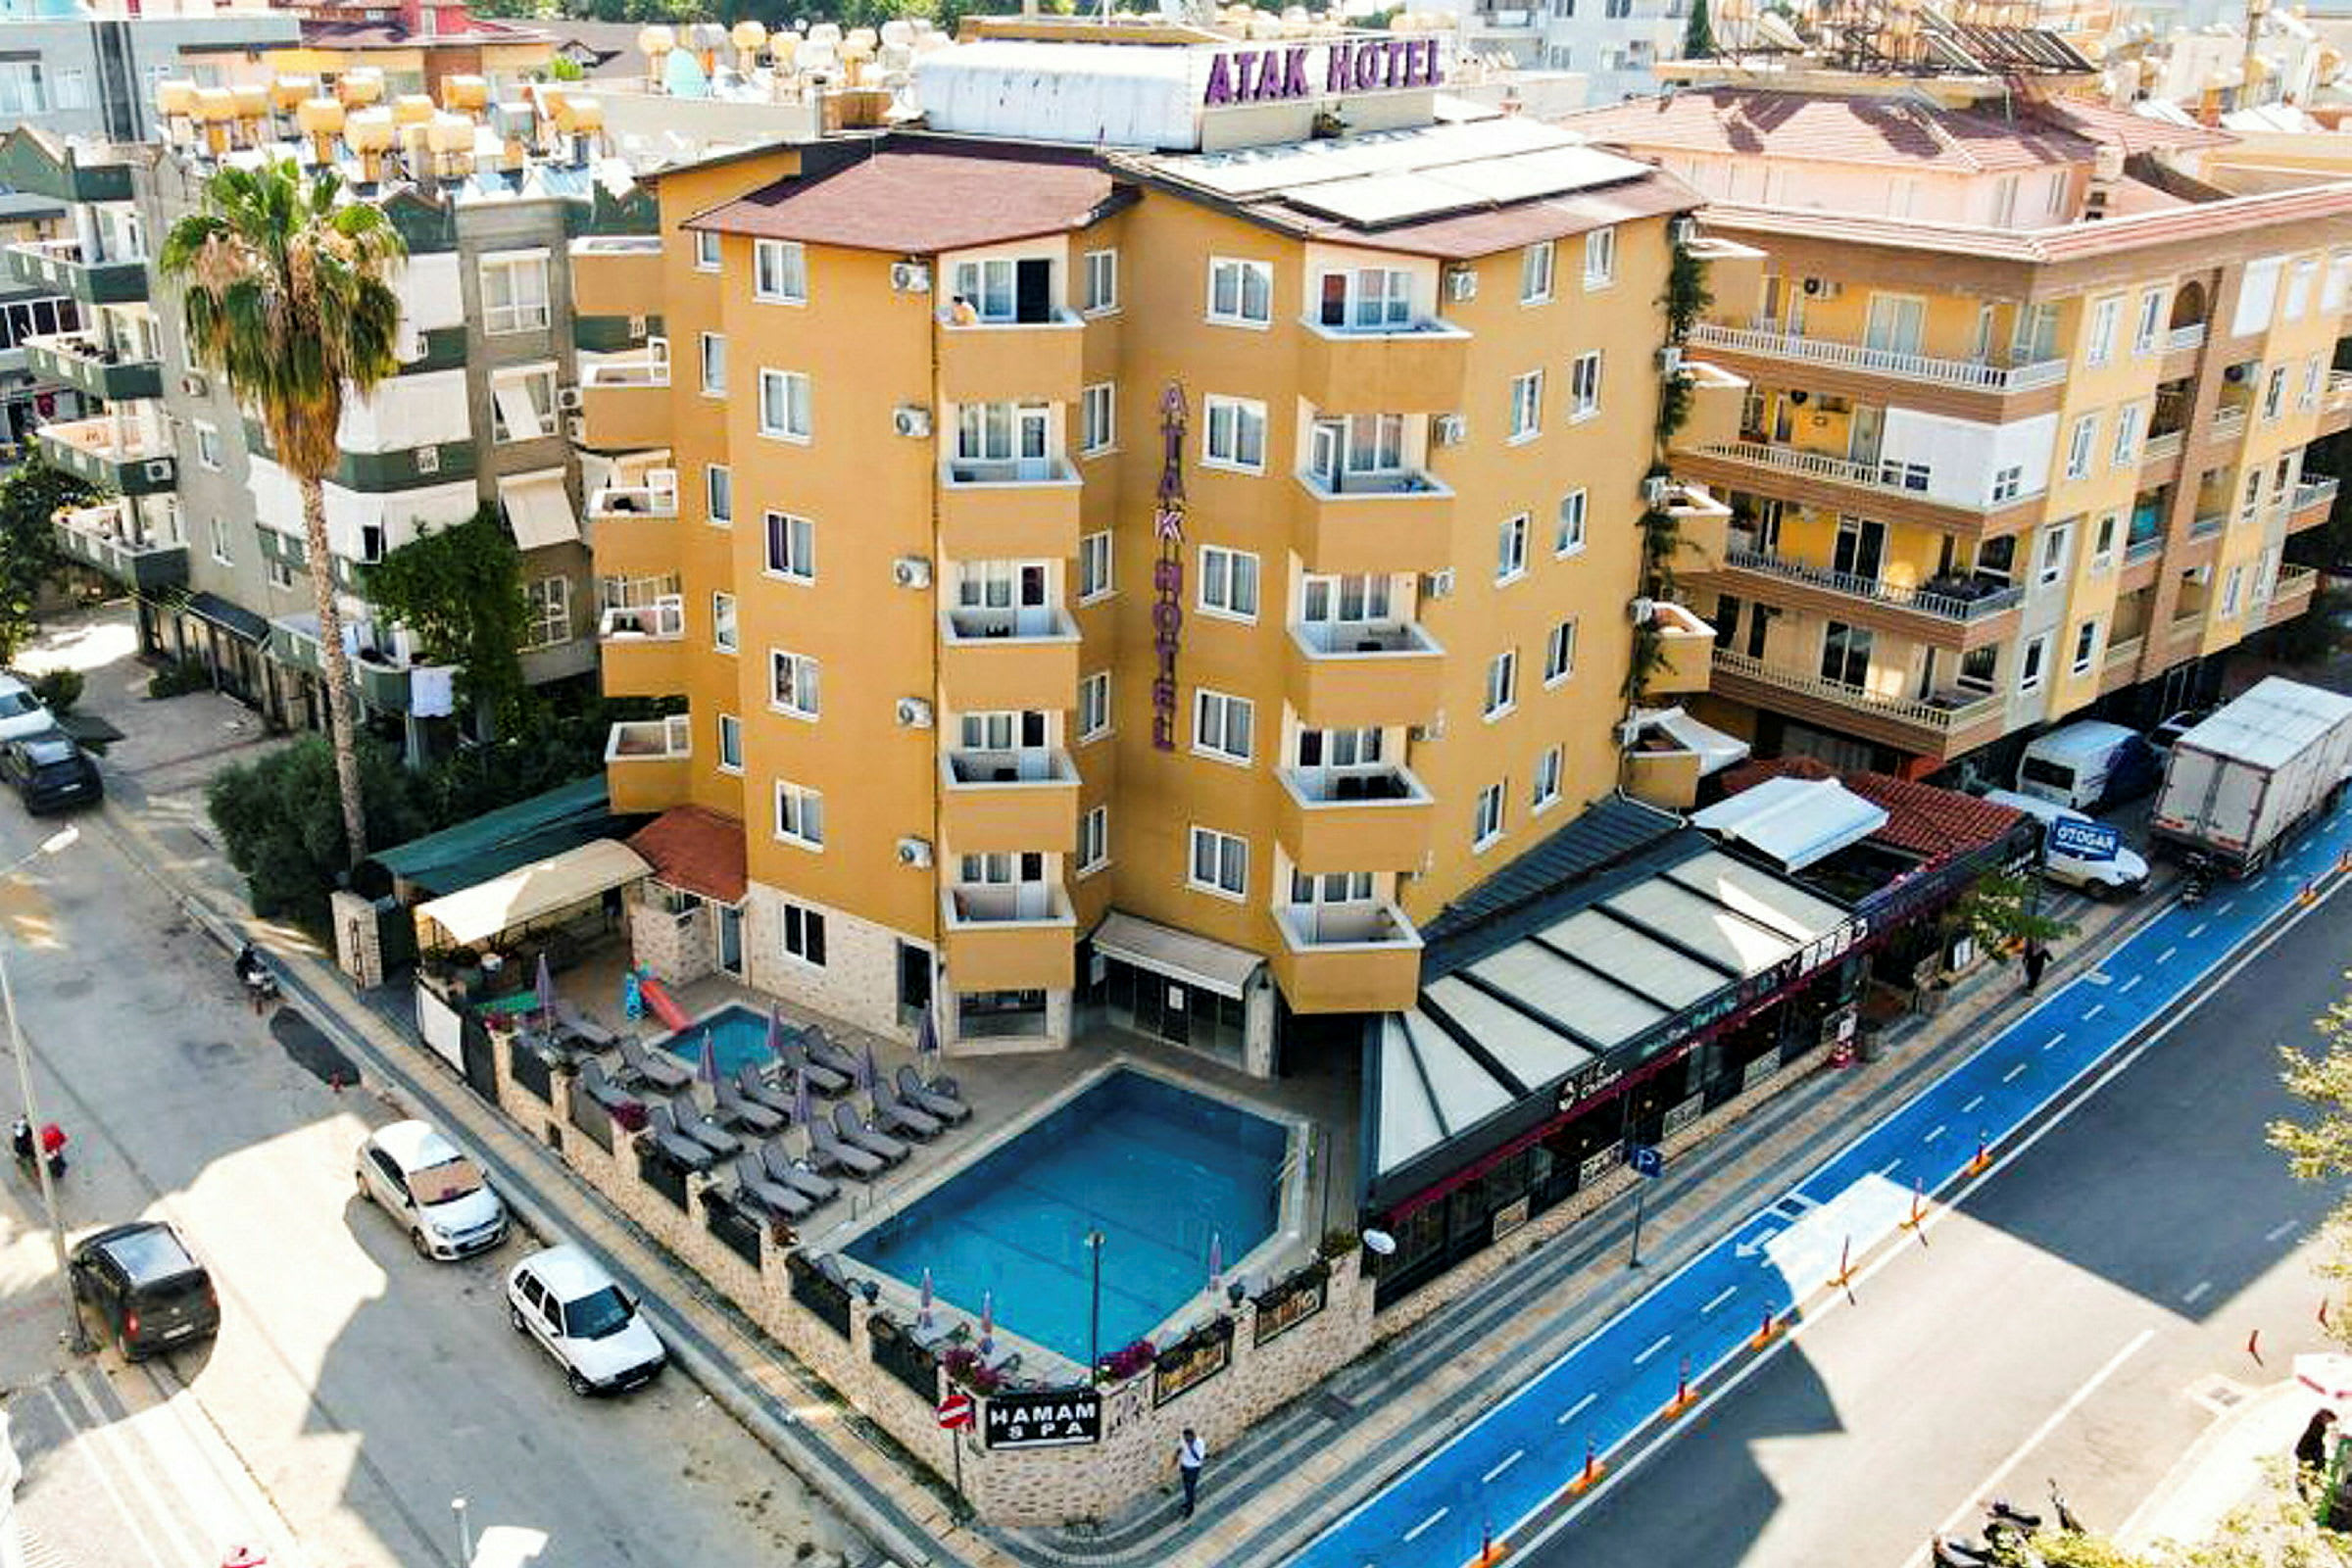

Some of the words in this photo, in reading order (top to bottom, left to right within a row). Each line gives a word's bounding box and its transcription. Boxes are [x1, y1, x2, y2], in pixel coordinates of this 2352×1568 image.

[1203, 47, 1309, 107] ATAK
[1326, 38, 1446, 95] HOTEL
[1153, 380, 1188, 544] ATAK
[2057, 825, 2116, 851] OTOGAR
[1637, 1149, 1656, 1171] P
[990, 1401, 1097, 1427] HAMAM
[1007, 1421, 1085, 1441] SPA
